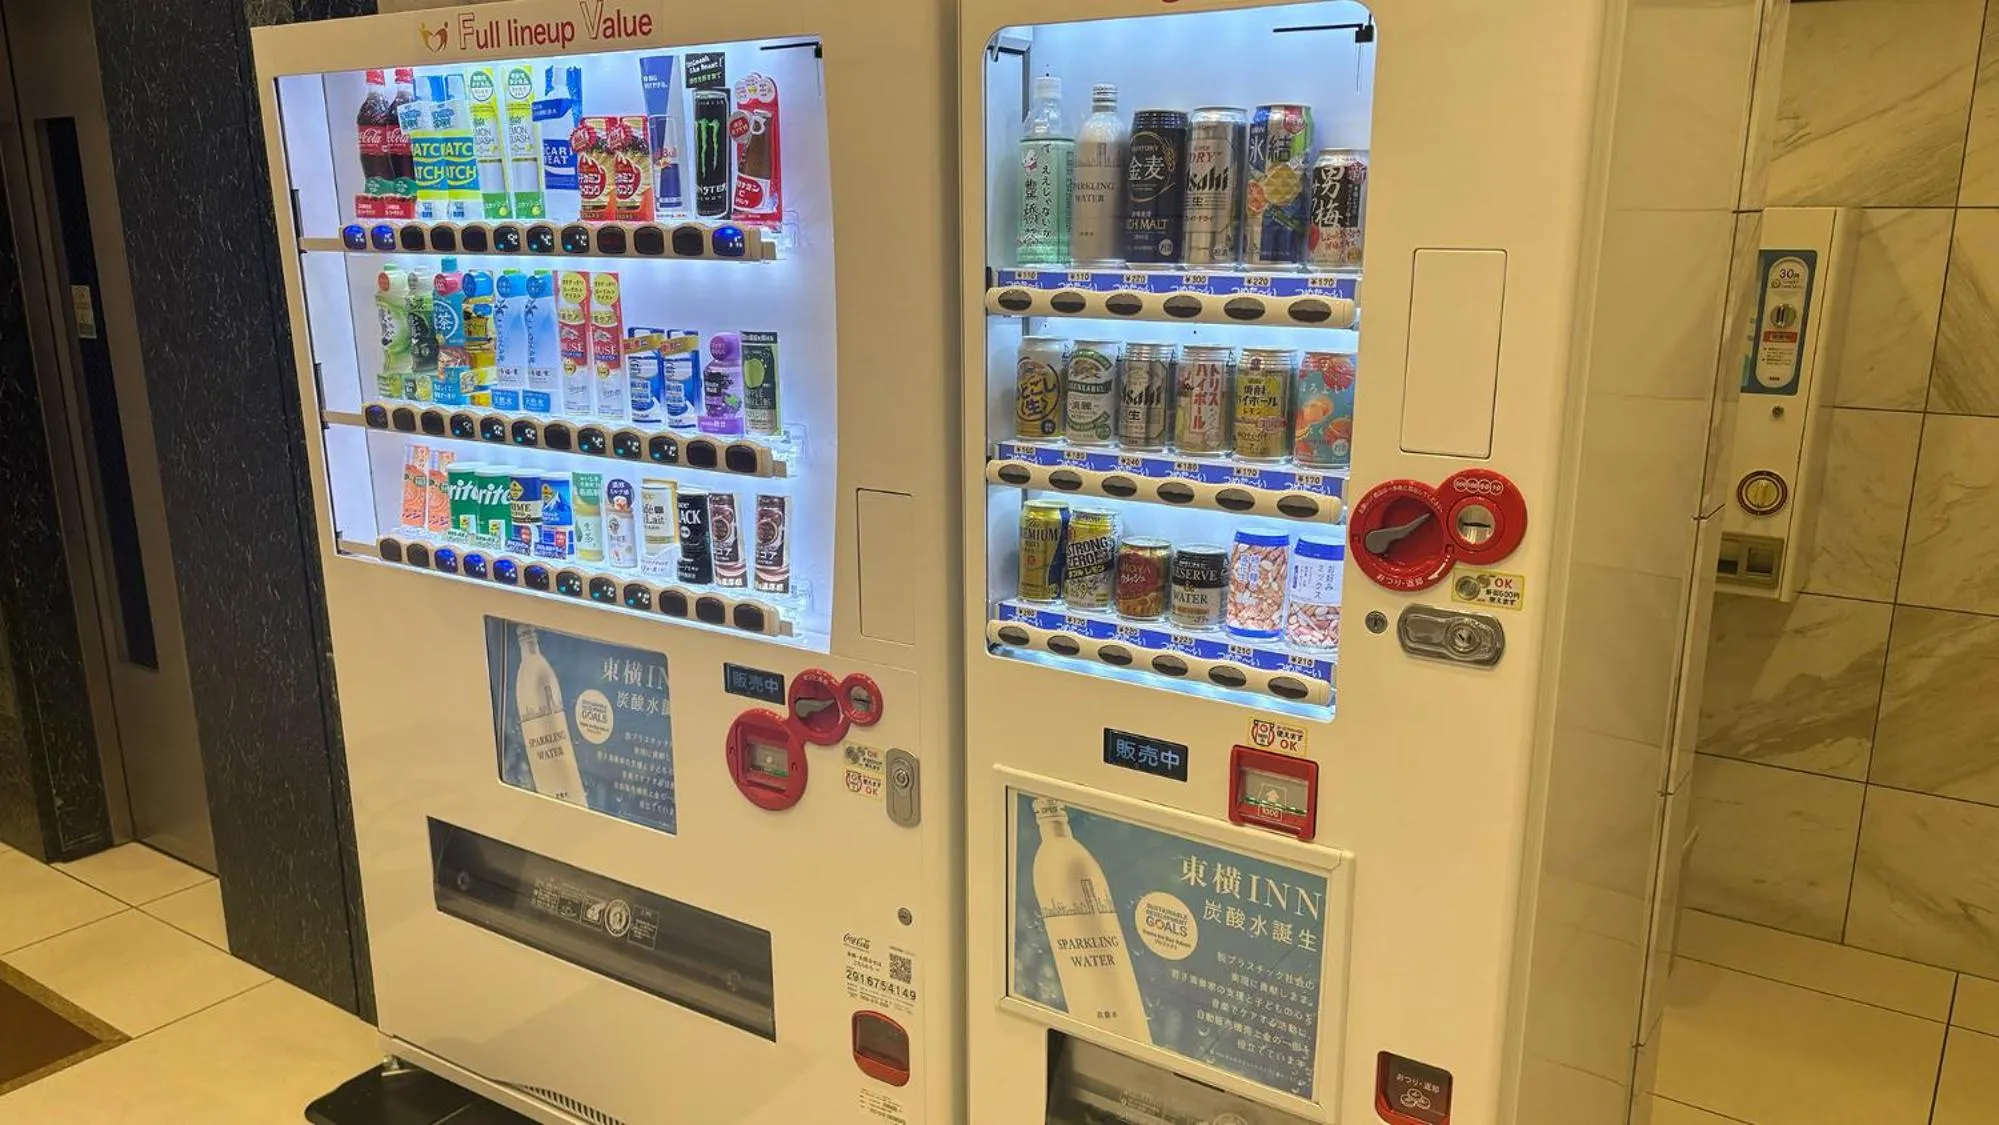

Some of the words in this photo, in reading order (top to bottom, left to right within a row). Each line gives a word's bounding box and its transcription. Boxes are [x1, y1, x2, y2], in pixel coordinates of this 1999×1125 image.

[458, 12, 500, 50] Full
[507, 18, 575, 48] lineup
[580, 0, 653, 40] Value
[1249, 136, 1292, 163] 氷結
[1128, 154, 1165, 181] 金麦
[1193, 363, 1208, 430] ハイボール
[1495, 578, 1513, 589] OK
[732, 671, 779, 694] 販売中
[1116, 739, 1180, 770] 販売中
[1280, 739, 1298, 752] OK
[1180, 855, 1322, 921] 東横INN
[1146, 916, 1188, 938] GOALS
[1203, 899, 1318, 953] 炭酸水誕生
[1057, 936, 1119, 951] SPARKLING
[1071, 956, 1116, 968] WATER
[846, 969, 917, 1001] 2916754149
